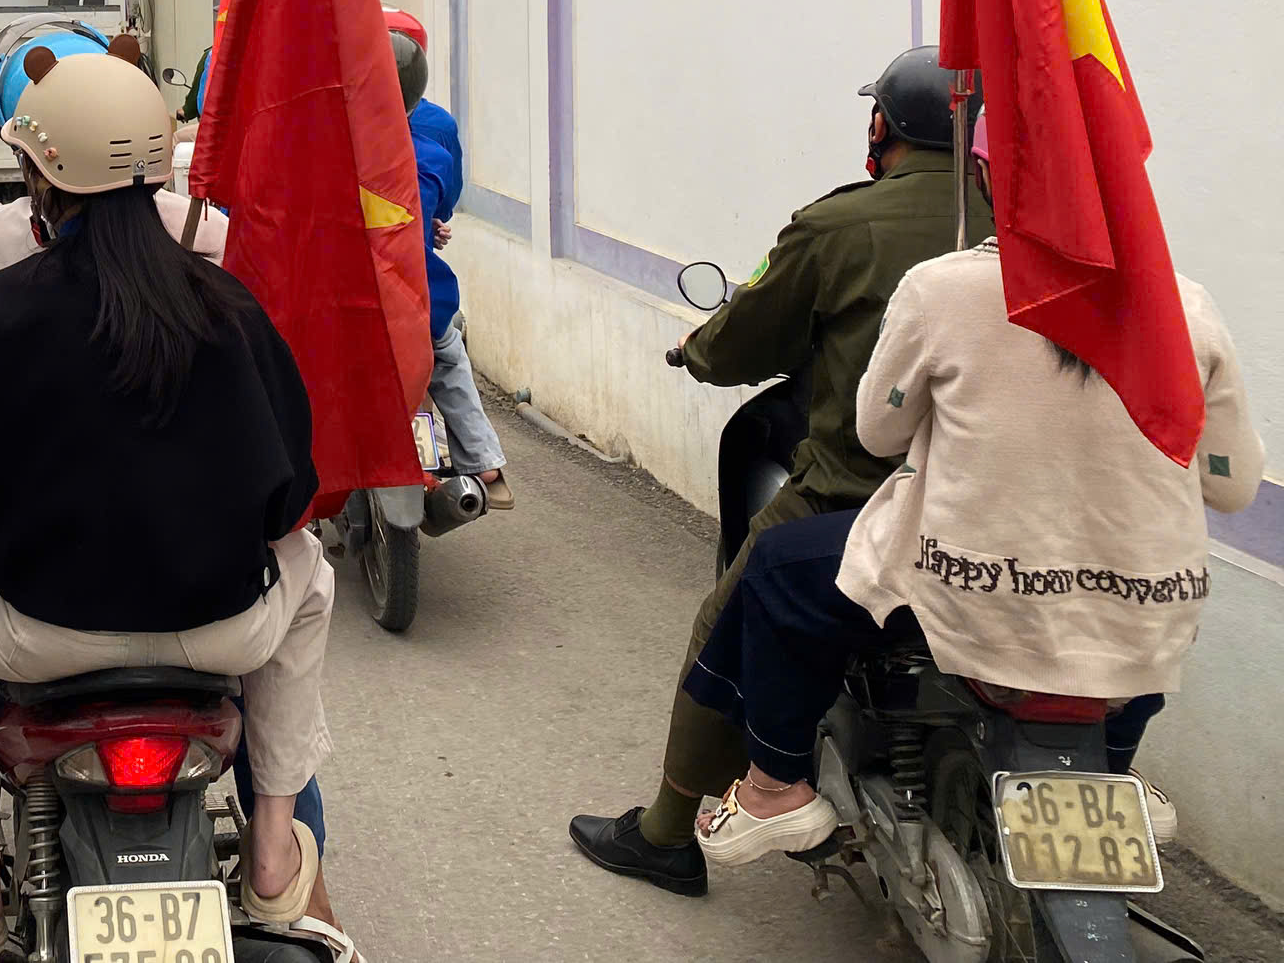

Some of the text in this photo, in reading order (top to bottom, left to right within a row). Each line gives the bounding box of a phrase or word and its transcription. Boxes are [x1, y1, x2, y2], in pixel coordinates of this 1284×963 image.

[915, 535, 1003, 593] Happy
[1016, 781, 1126, 830] 36-B4
[116, 853, 170, 864] HONDA
[93, 891, 202, 945] 36-B7
